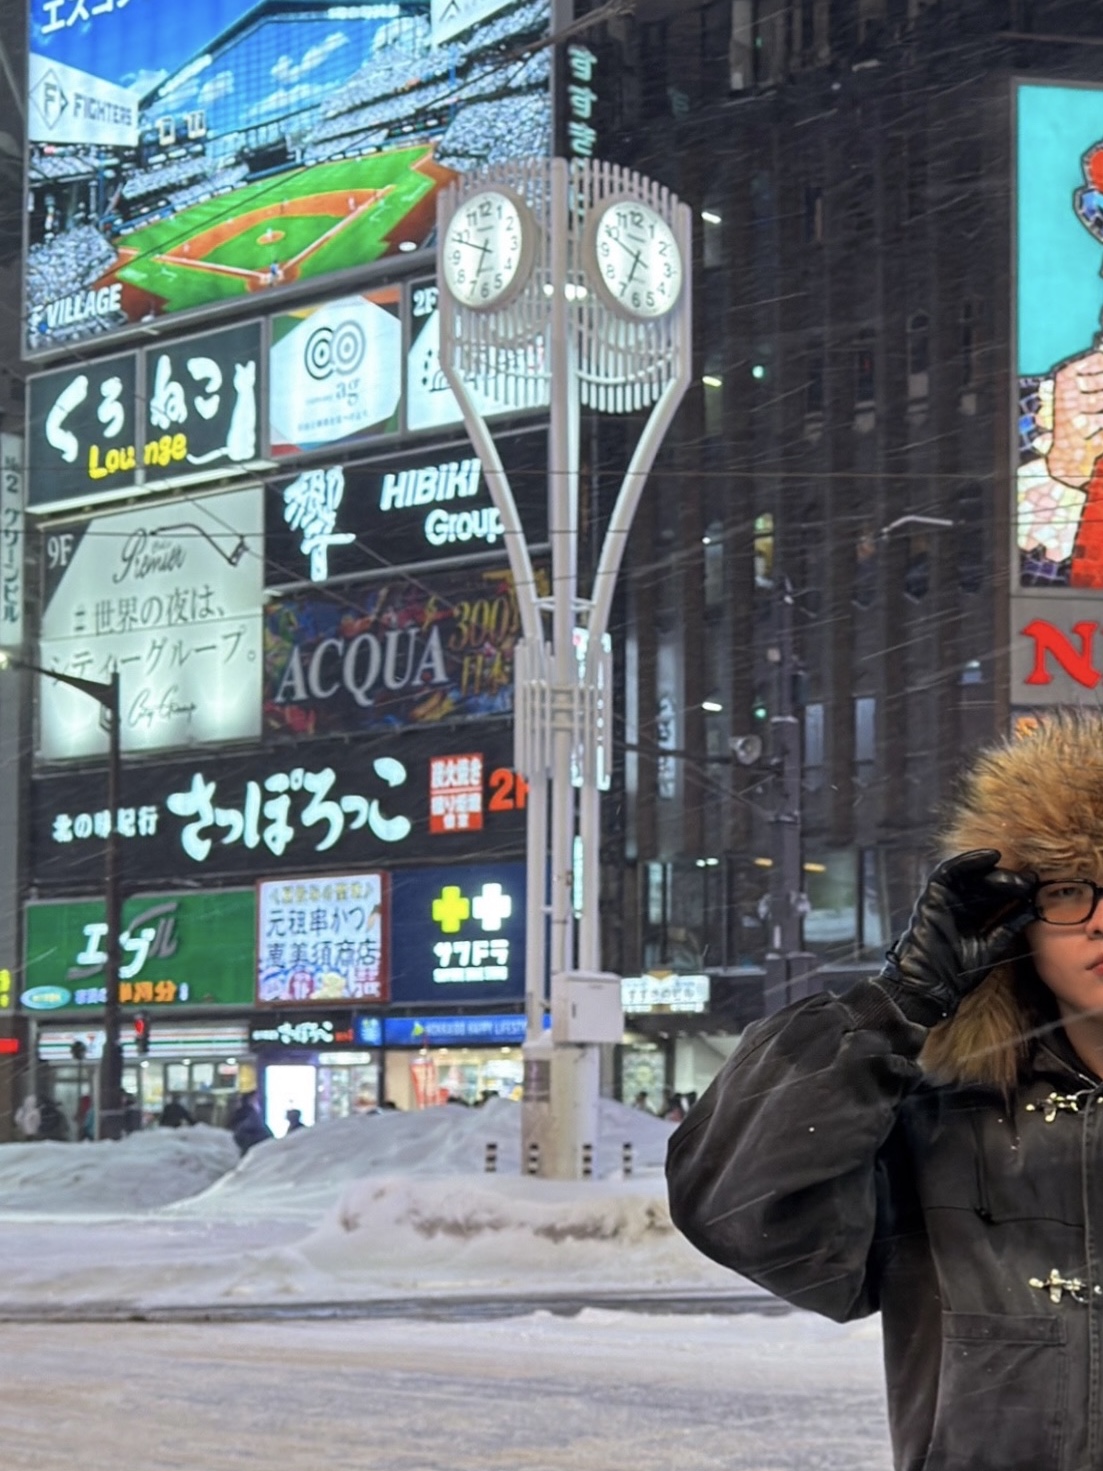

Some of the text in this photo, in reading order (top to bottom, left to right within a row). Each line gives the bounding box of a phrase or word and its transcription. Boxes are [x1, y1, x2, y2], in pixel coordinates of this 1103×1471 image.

[479, 201, 492, 218] 12
[497, 205, 502, 219] 1
[467, 211, 478, 227] 11
[506, 216, 514, 231] 2
[616, 211, 628, 228] 11
[630, 210, 644, 226] 12
[649, 224, 656, 239] 1
[511, 236, 517, 251] 3
[601, 241, 610, 257] 9
[659, 241, 671, 256] 2
[452, 250, 461, 265] 9
[504, 255, 512, 270] 4
[457, 269, 465, 284] 8
[606, 264, 616, 279] 8
[663, 263, 673, 278] 3
[470, 280, 477, 296] 7
[494, 273, 502, 289] 5
[659, 282, 666, 295] 4
[481, 282, 490, 298] 6
[619, 282, 628, 297] 7
[47, 283, 123, 327] VILLAGE
[632, 292, 641, 308] 6
[647, 291, 655, 307] 5
[46, 354, 222, 462] くろねこ
[89, 433, 187, 479] Lounge
[380, 458, 481, 511] HIBIKI
[424, 507, 505, 545] Group
[48, 534, 74, 569] 9F
[275, 625, 449, 707] ACQUA
[266, 906, 366, 937] 元祖串かつ
[74, 903, 178, 979] エブル
